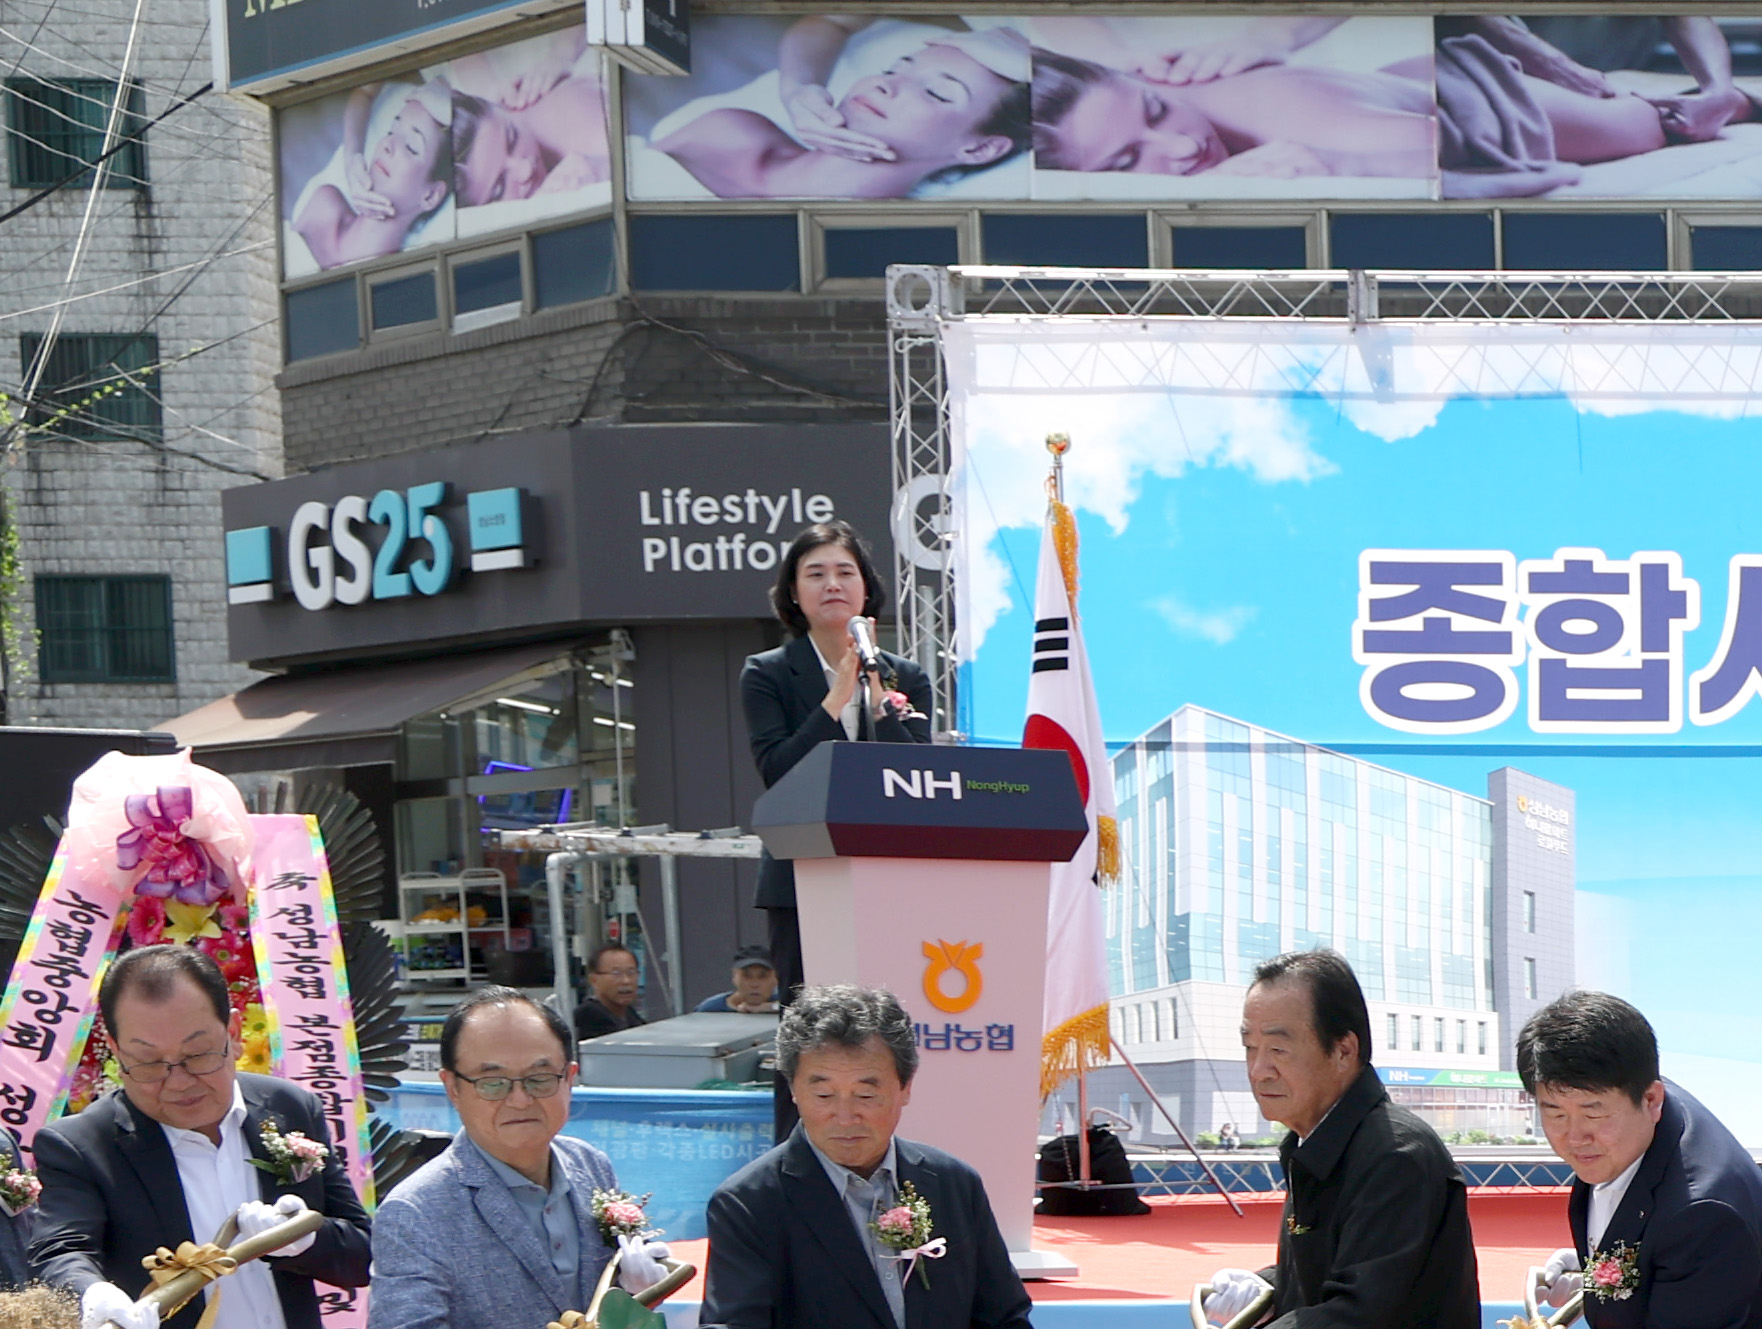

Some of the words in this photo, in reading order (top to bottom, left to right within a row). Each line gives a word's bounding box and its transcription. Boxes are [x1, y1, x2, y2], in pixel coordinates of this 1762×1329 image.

[289, 481, 453, 611] GS25
[640, 487, 835, 534] Lifestyle
[642, 533, 794, 572] Platfor
[883, 768, 962, 800] NH
[966, 780, 1031, 794] NongHyup
[1, 888, 110, 1063] 농협중앙회
[267, 903, 331, 1000] 성남농협
